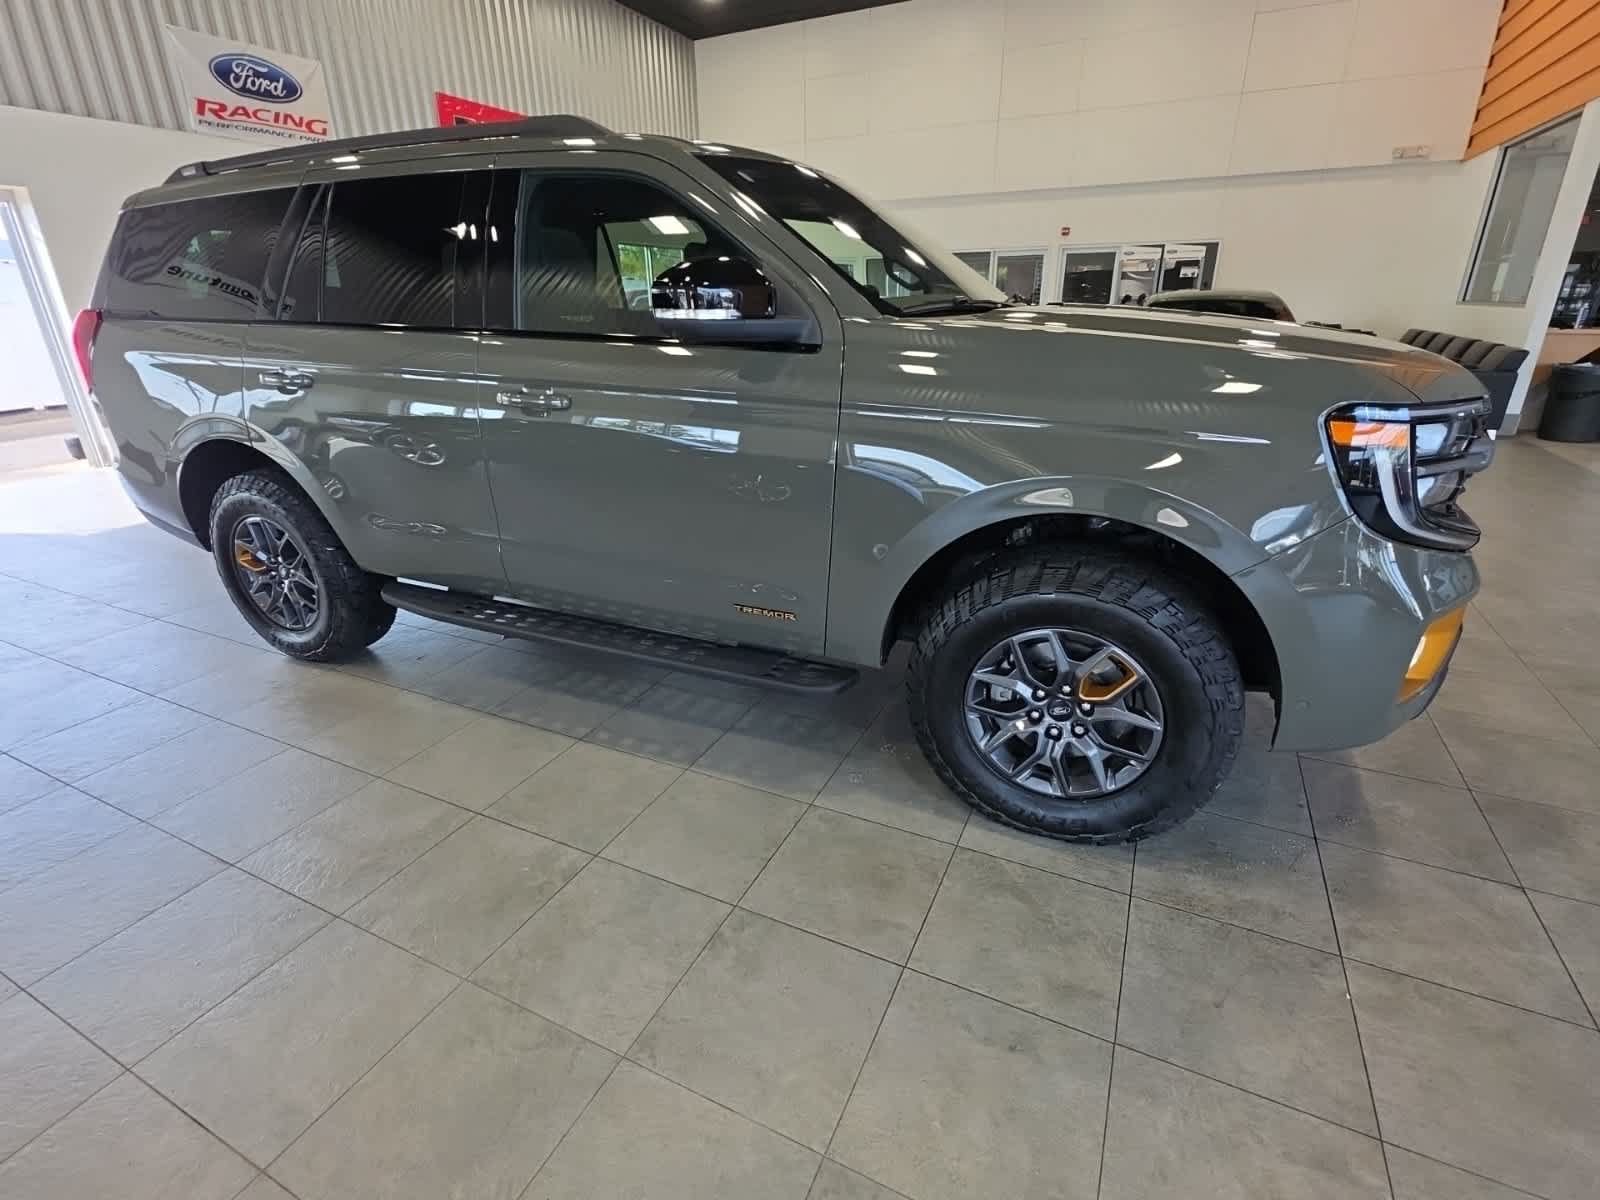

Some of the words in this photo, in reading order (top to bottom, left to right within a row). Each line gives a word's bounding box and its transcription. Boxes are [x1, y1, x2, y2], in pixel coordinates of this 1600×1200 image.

[230, 60, 287, 97] Ford
[195, 98, 328, 136] RACING
[198, 120, 296, 139] PERFORMANCE
[733, 604, 797, 621] TREMOR
